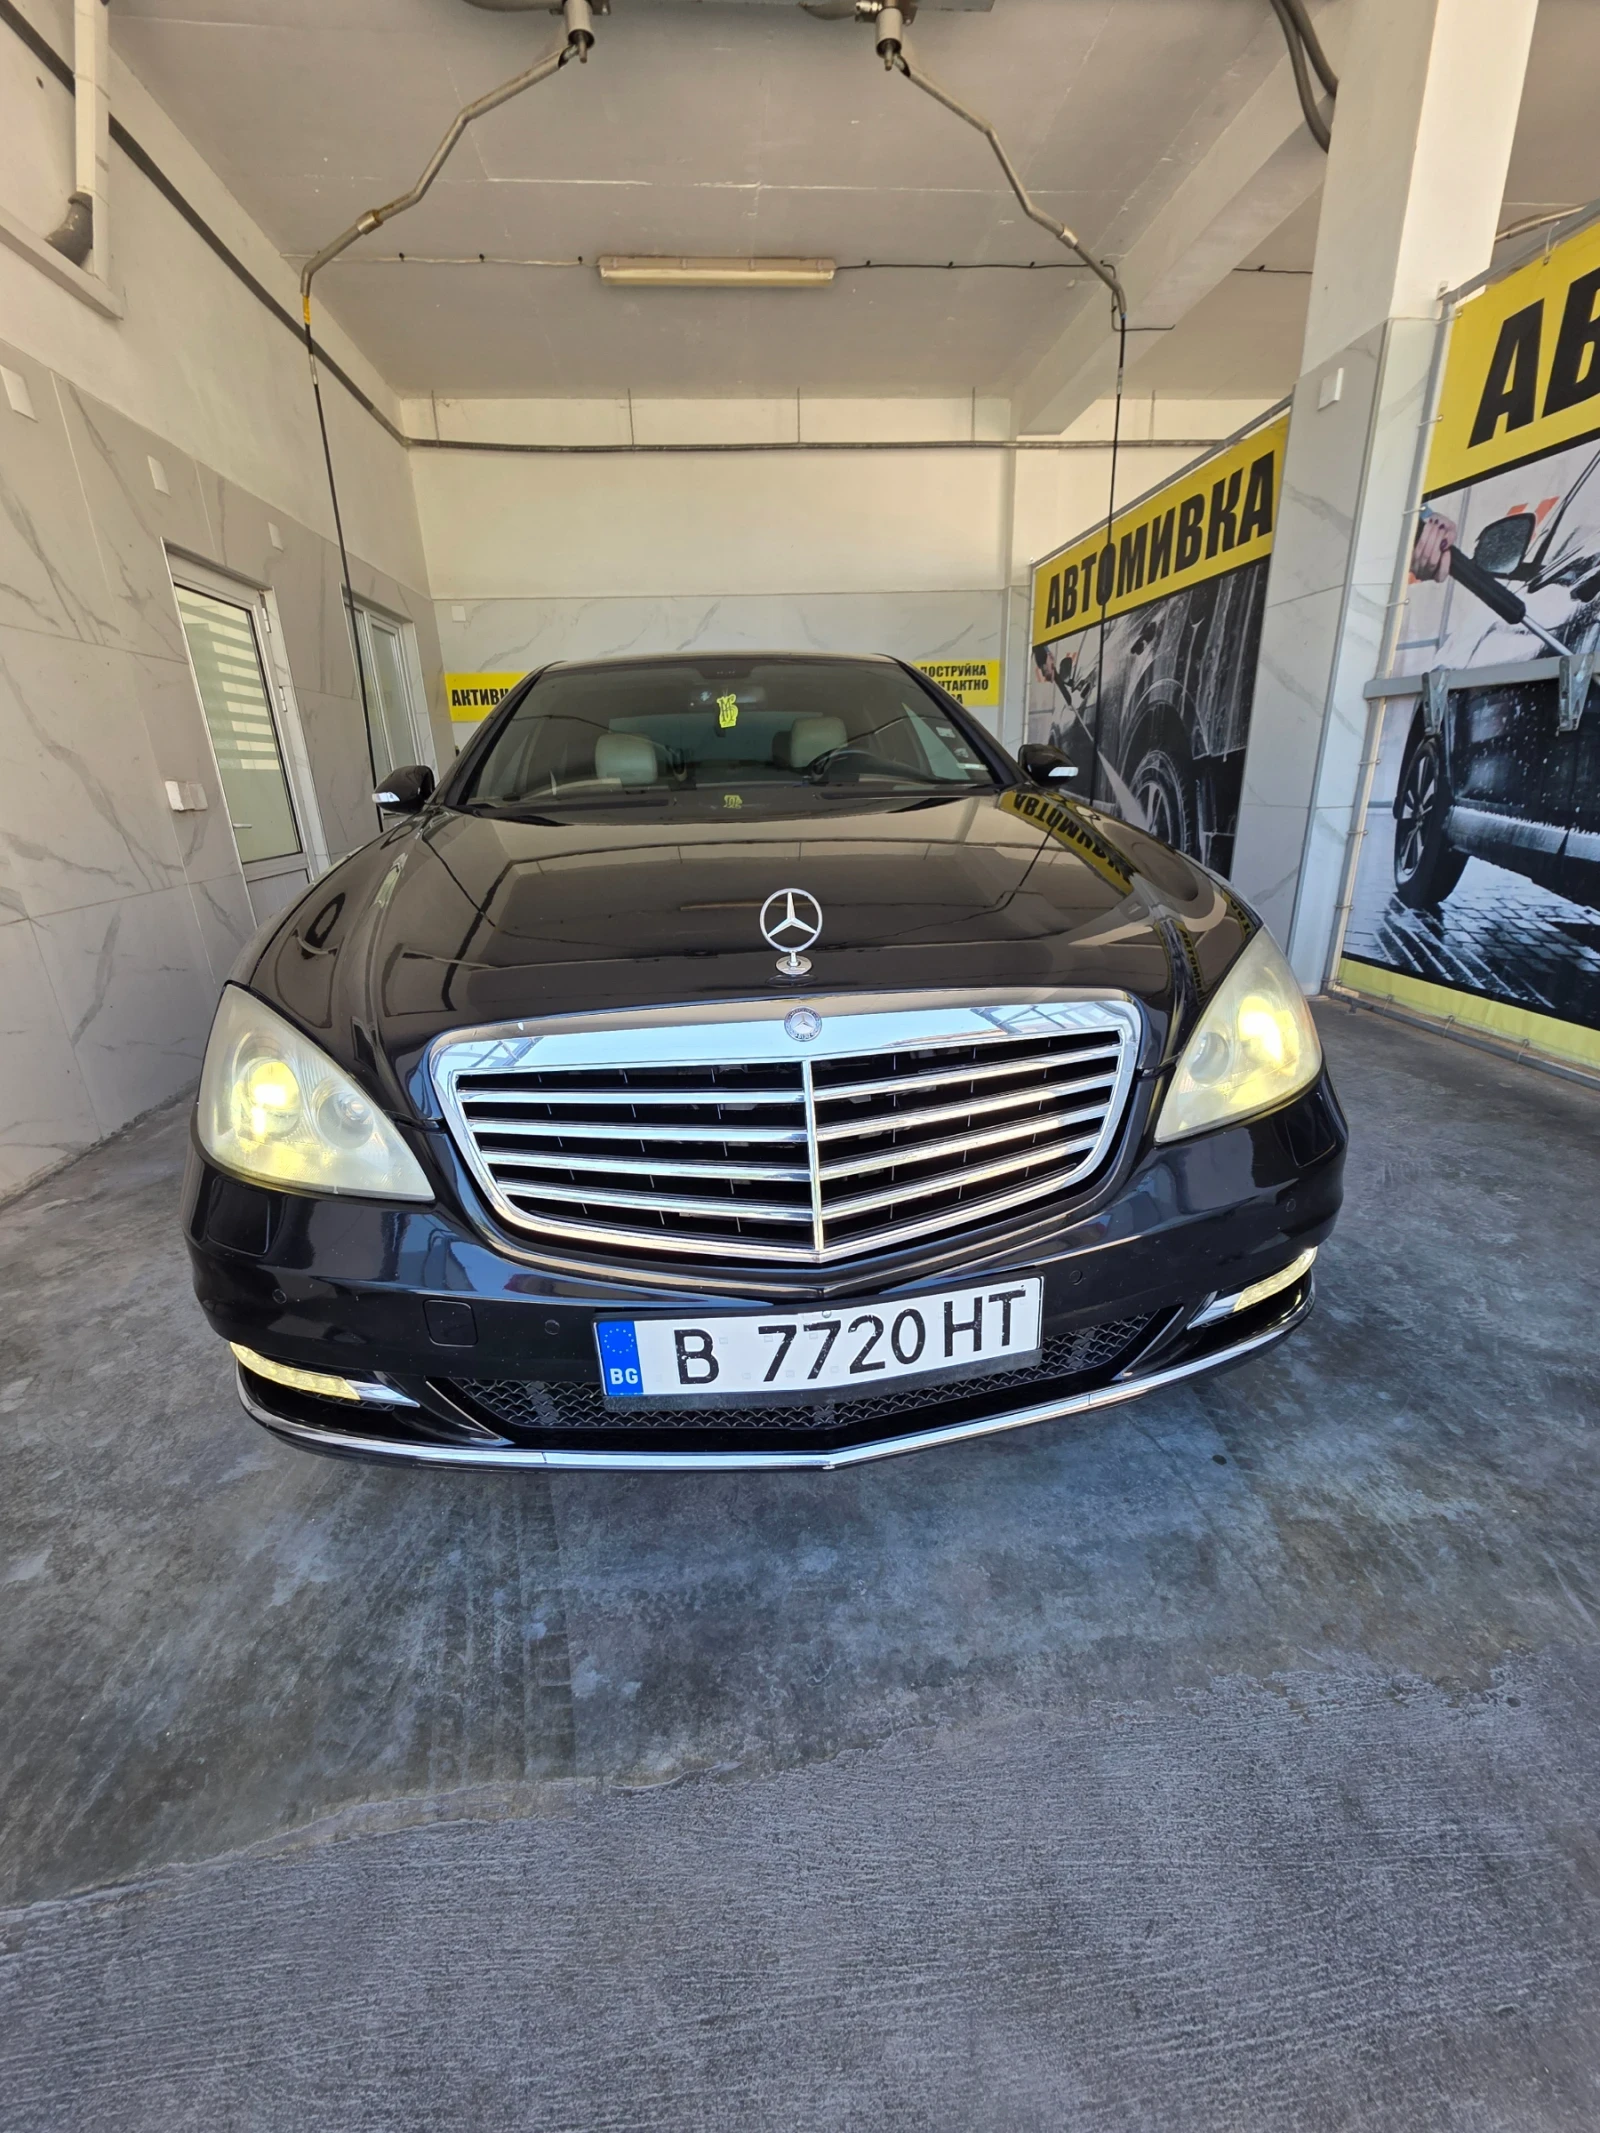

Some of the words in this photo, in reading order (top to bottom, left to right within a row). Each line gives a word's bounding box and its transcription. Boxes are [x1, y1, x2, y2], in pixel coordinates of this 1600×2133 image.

[1044, 449, 1275, 630] АВТОМИВКА
[609, 1367, 639, 1385] BG
[673, 1328, 719, 1384] B
[757, 1308, 926, 1383] 7720
[943, 1287, 1026, 1358] HT
